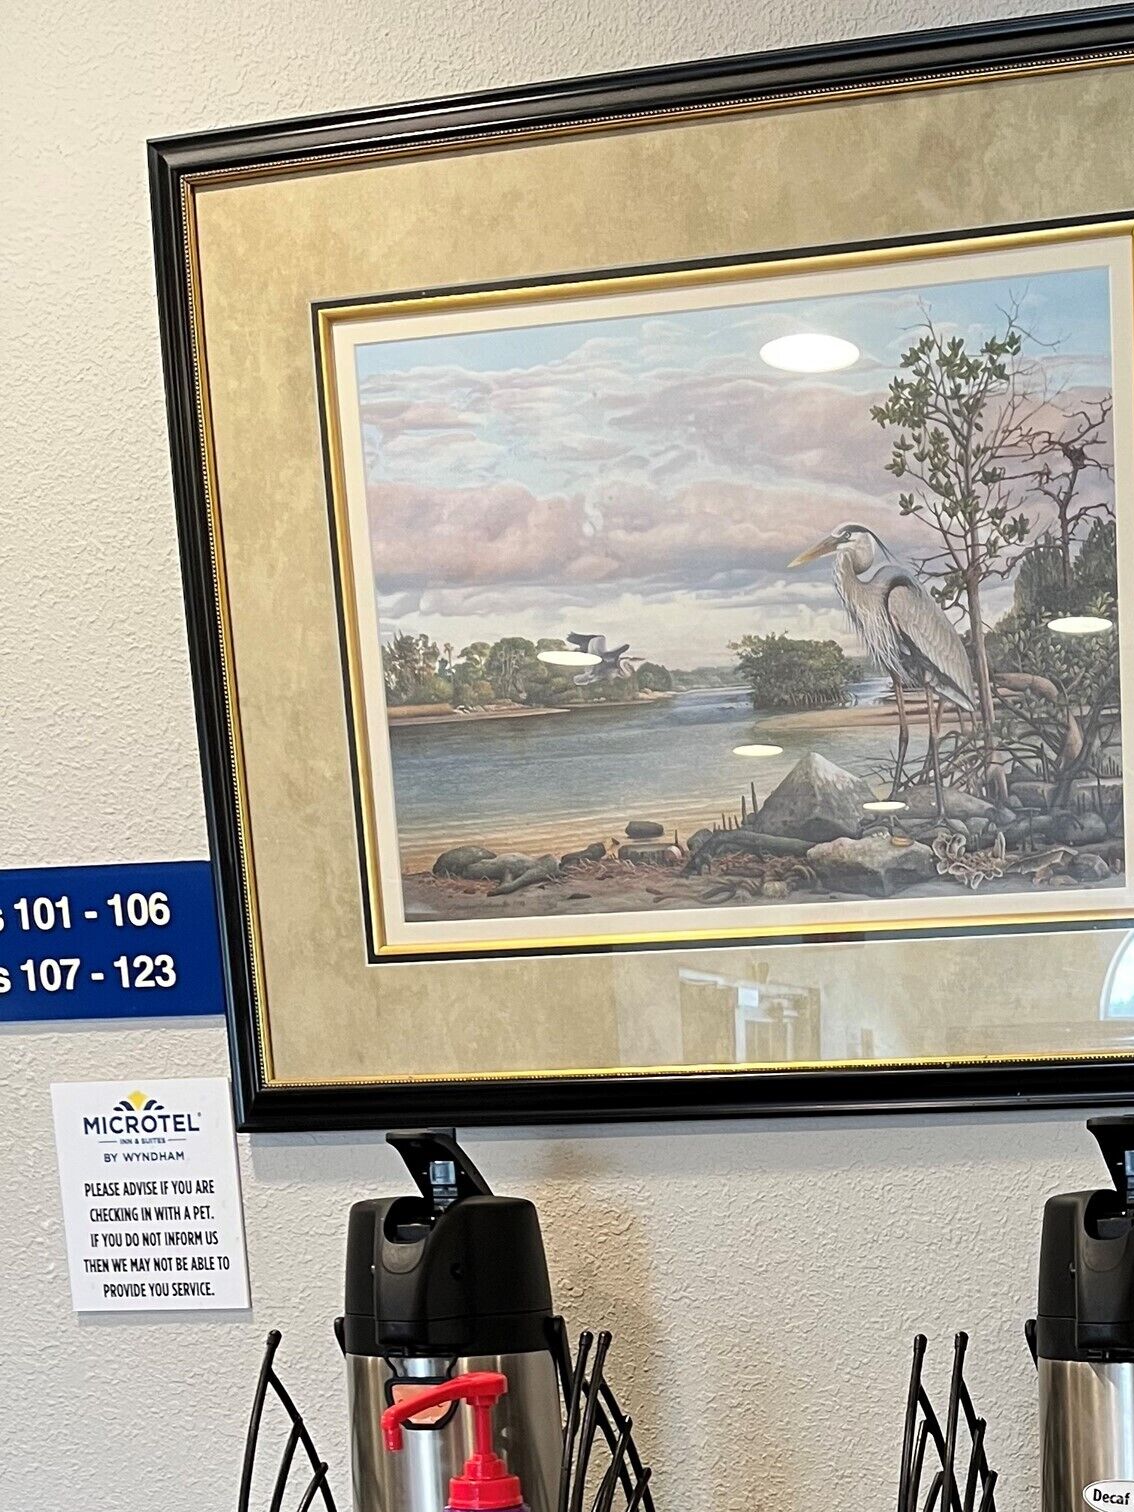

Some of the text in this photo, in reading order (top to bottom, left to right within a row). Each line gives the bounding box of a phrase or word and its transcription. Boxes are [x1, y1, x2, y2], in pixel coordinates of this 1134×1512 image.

[14, 896, 71, 930] 101
[84, 910, 98, 919] -
[107, 892, 170, 927] 106
[20, 958, 81, 992] 107
[91, 972, 104, 981] -
[114, 954, 177, 989] 123
[83, 1113, 200, 1135] MICROTEL
[103, 1151, 185, 1162] BY WYNDHAM
[84, 1179, 215, 1197] PLEASE ADVISE IF YOU ARE
[89, 1205, 215, 1222] CHECKING IN WITH A PET.
[90, 1230, 219, 1247] IF YOU DO NOT INFORM US
[83, 1255, 230, 1273] THEN WE MAY NOT BE ABLE TO
[103, 1281, 215, 1298] PROVIDE YOU SERVICE.
[1093, 1488, 1130, 1505] Decaf
